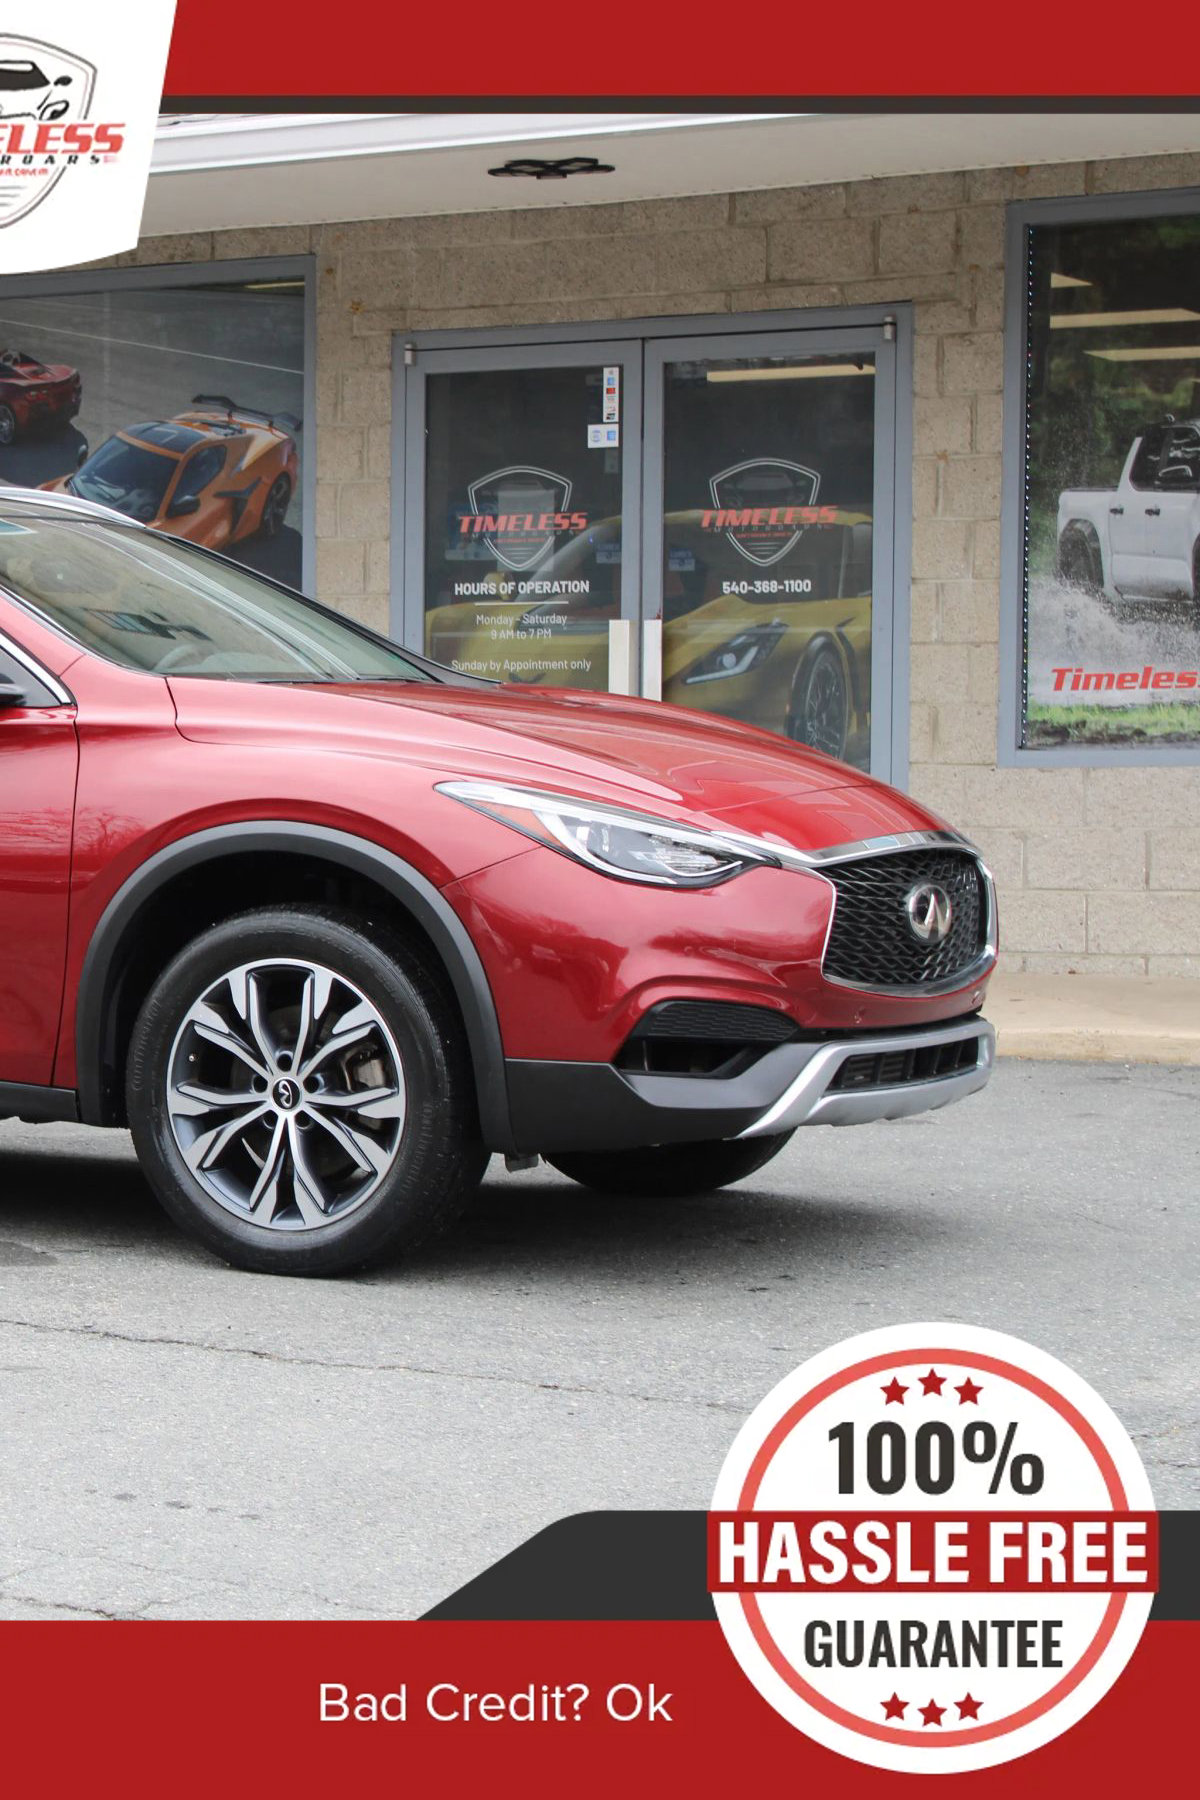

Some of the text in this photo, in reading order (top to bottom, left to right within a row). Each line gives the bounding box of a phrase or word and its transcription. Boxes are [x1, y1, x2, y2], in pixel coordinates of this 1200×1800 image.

[459, 512, 588, 533] TIMELESS
[701, 505, 838, 528] TIMELESS
[454, 580, 590, 595] HOURS OF OPERATION
[722, 579, 812, 594] 540-368-1100
[476, 614, 514, 626] Monday
[522, 613, 567, 626] Saturday
[491, 628, 552, 640] 9 AM to 7 PM
[451, 659, 592, 672] Sunday by Appointment only
[1052, 666, 1200, 691] Timeles
